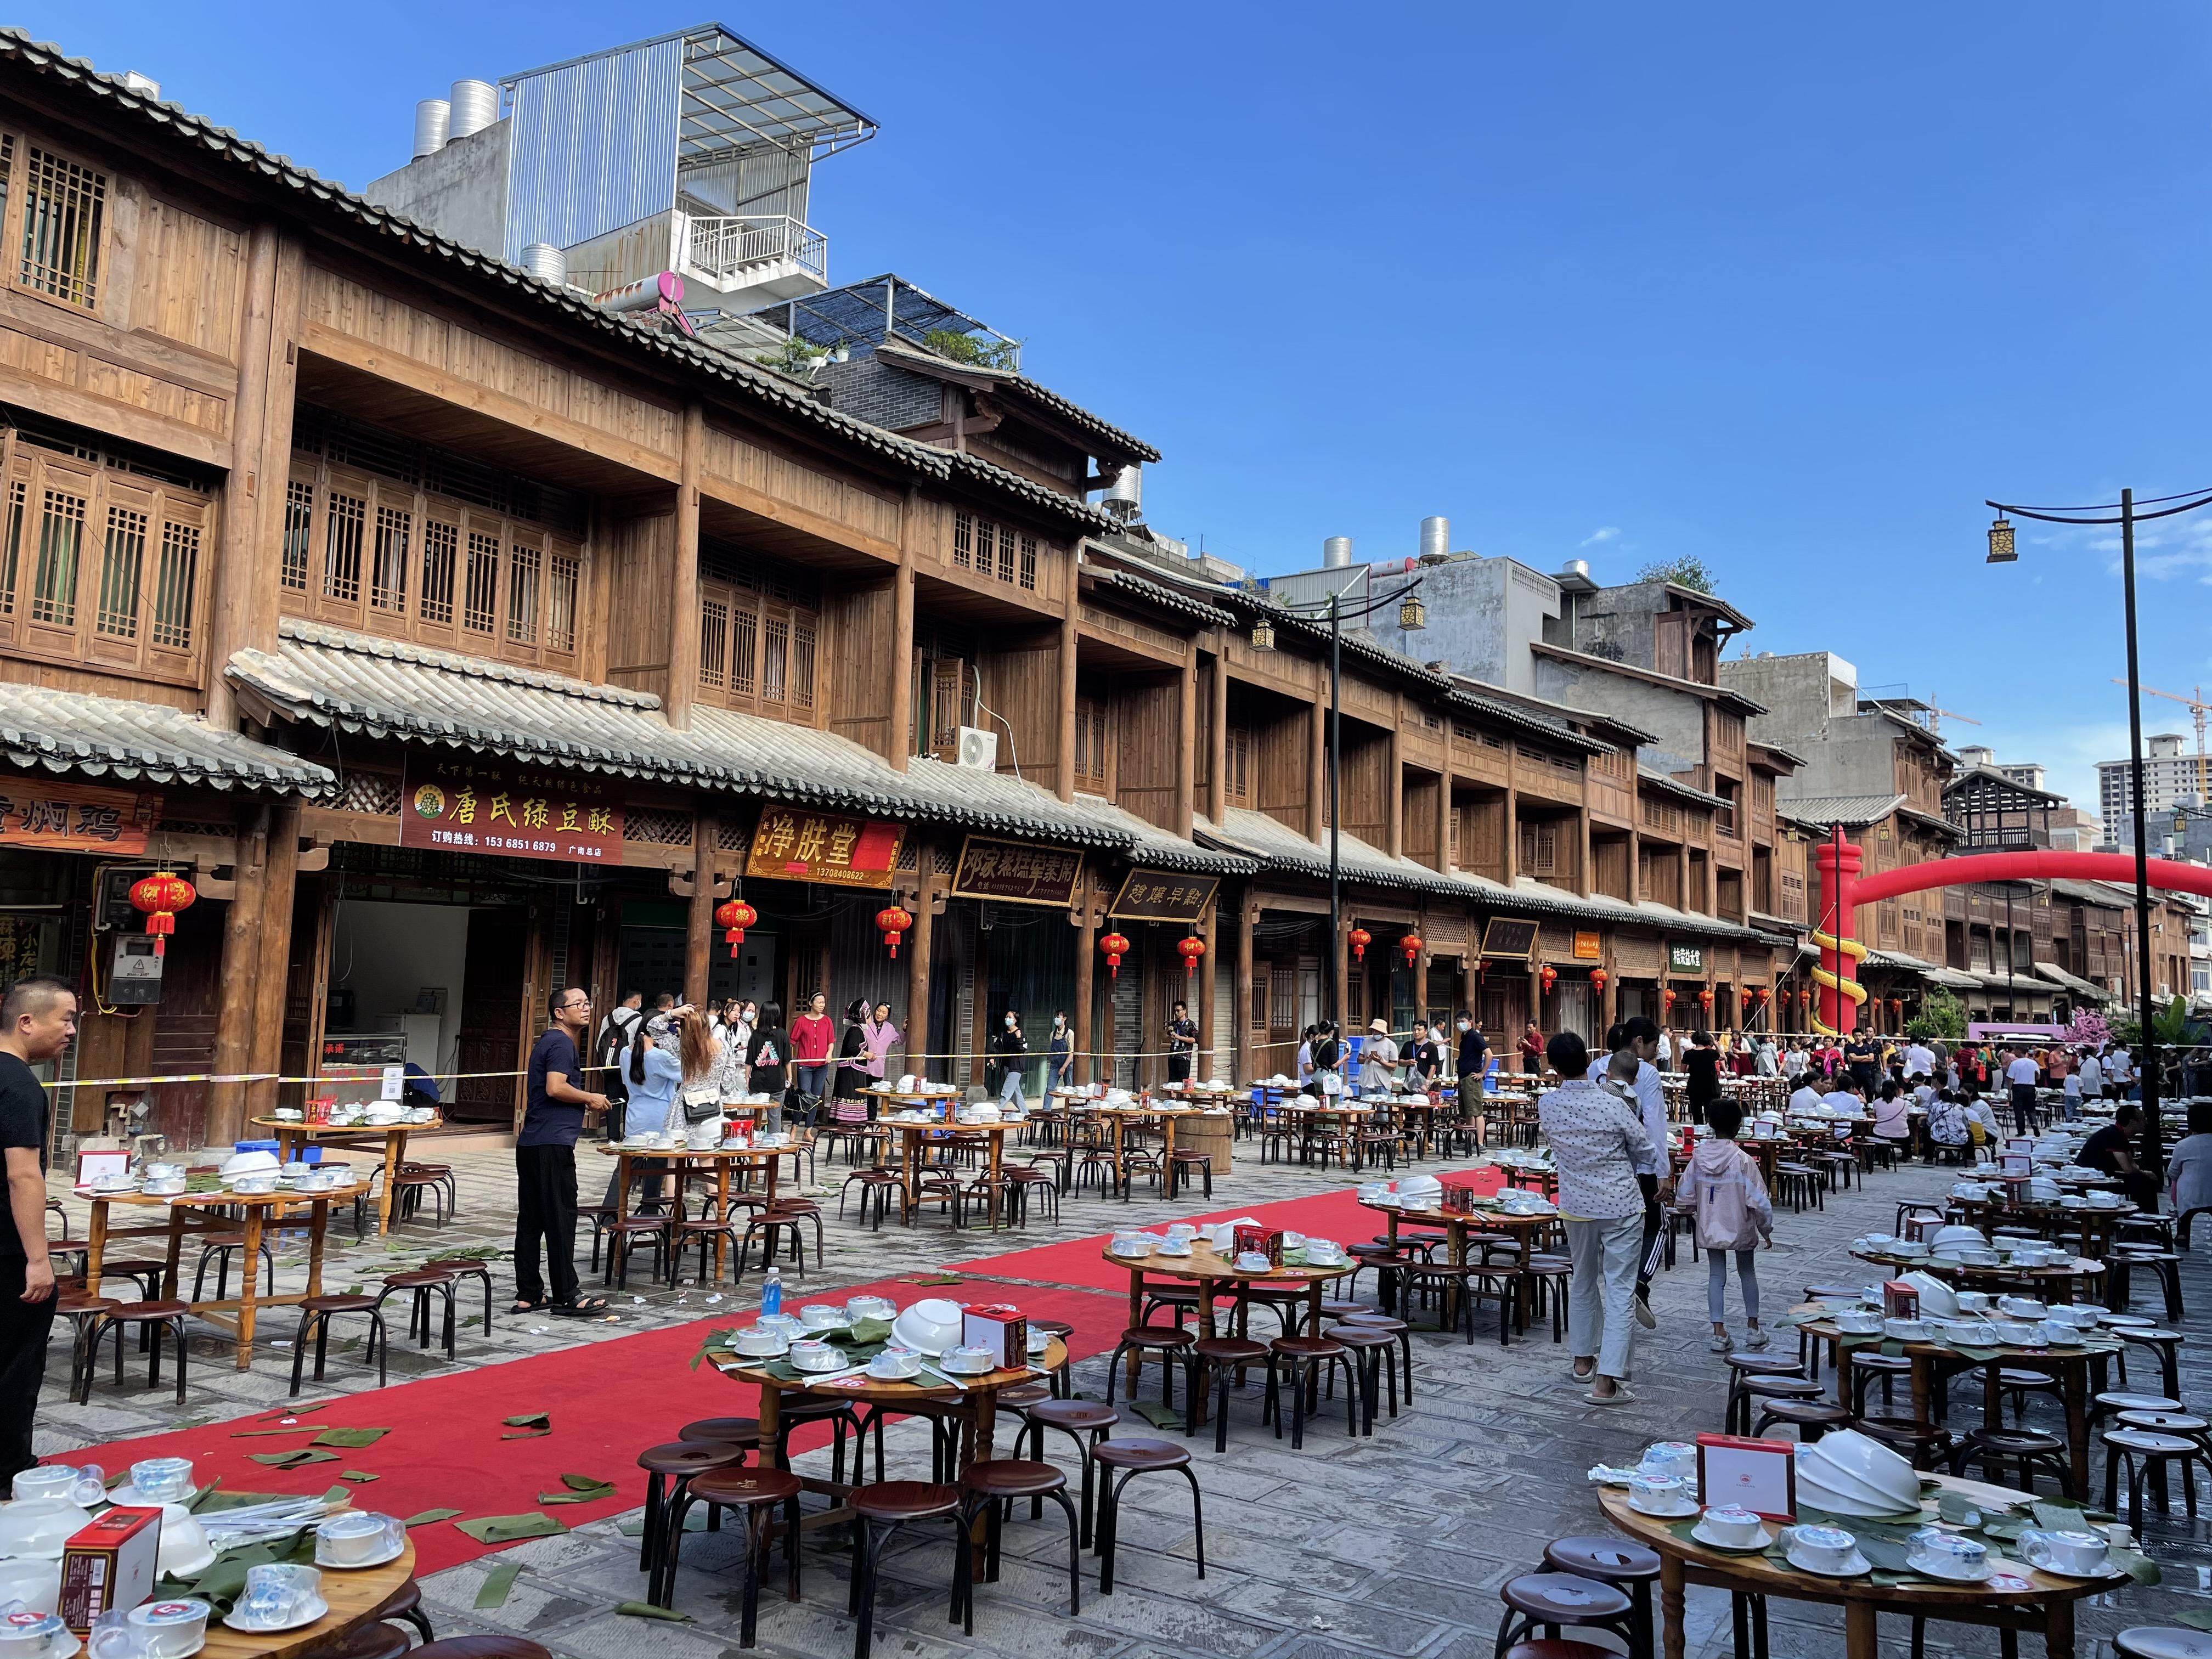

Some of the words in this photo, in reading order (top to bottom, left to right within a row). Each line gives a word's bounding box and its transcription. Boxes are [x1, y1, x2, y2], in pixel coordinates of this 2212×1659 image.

[449, 785, 616, 837] 唐氏绿豆酥
[485, 836, 503, 847] 153
[506, 838, 529, 850] 6851
[533, 840, 556, 853] 6879
[568, 845, 602, 857] 广南总店
[764, 814, 856, 864] 净肤堂
[816, 867, 865, 881] 13708408622
